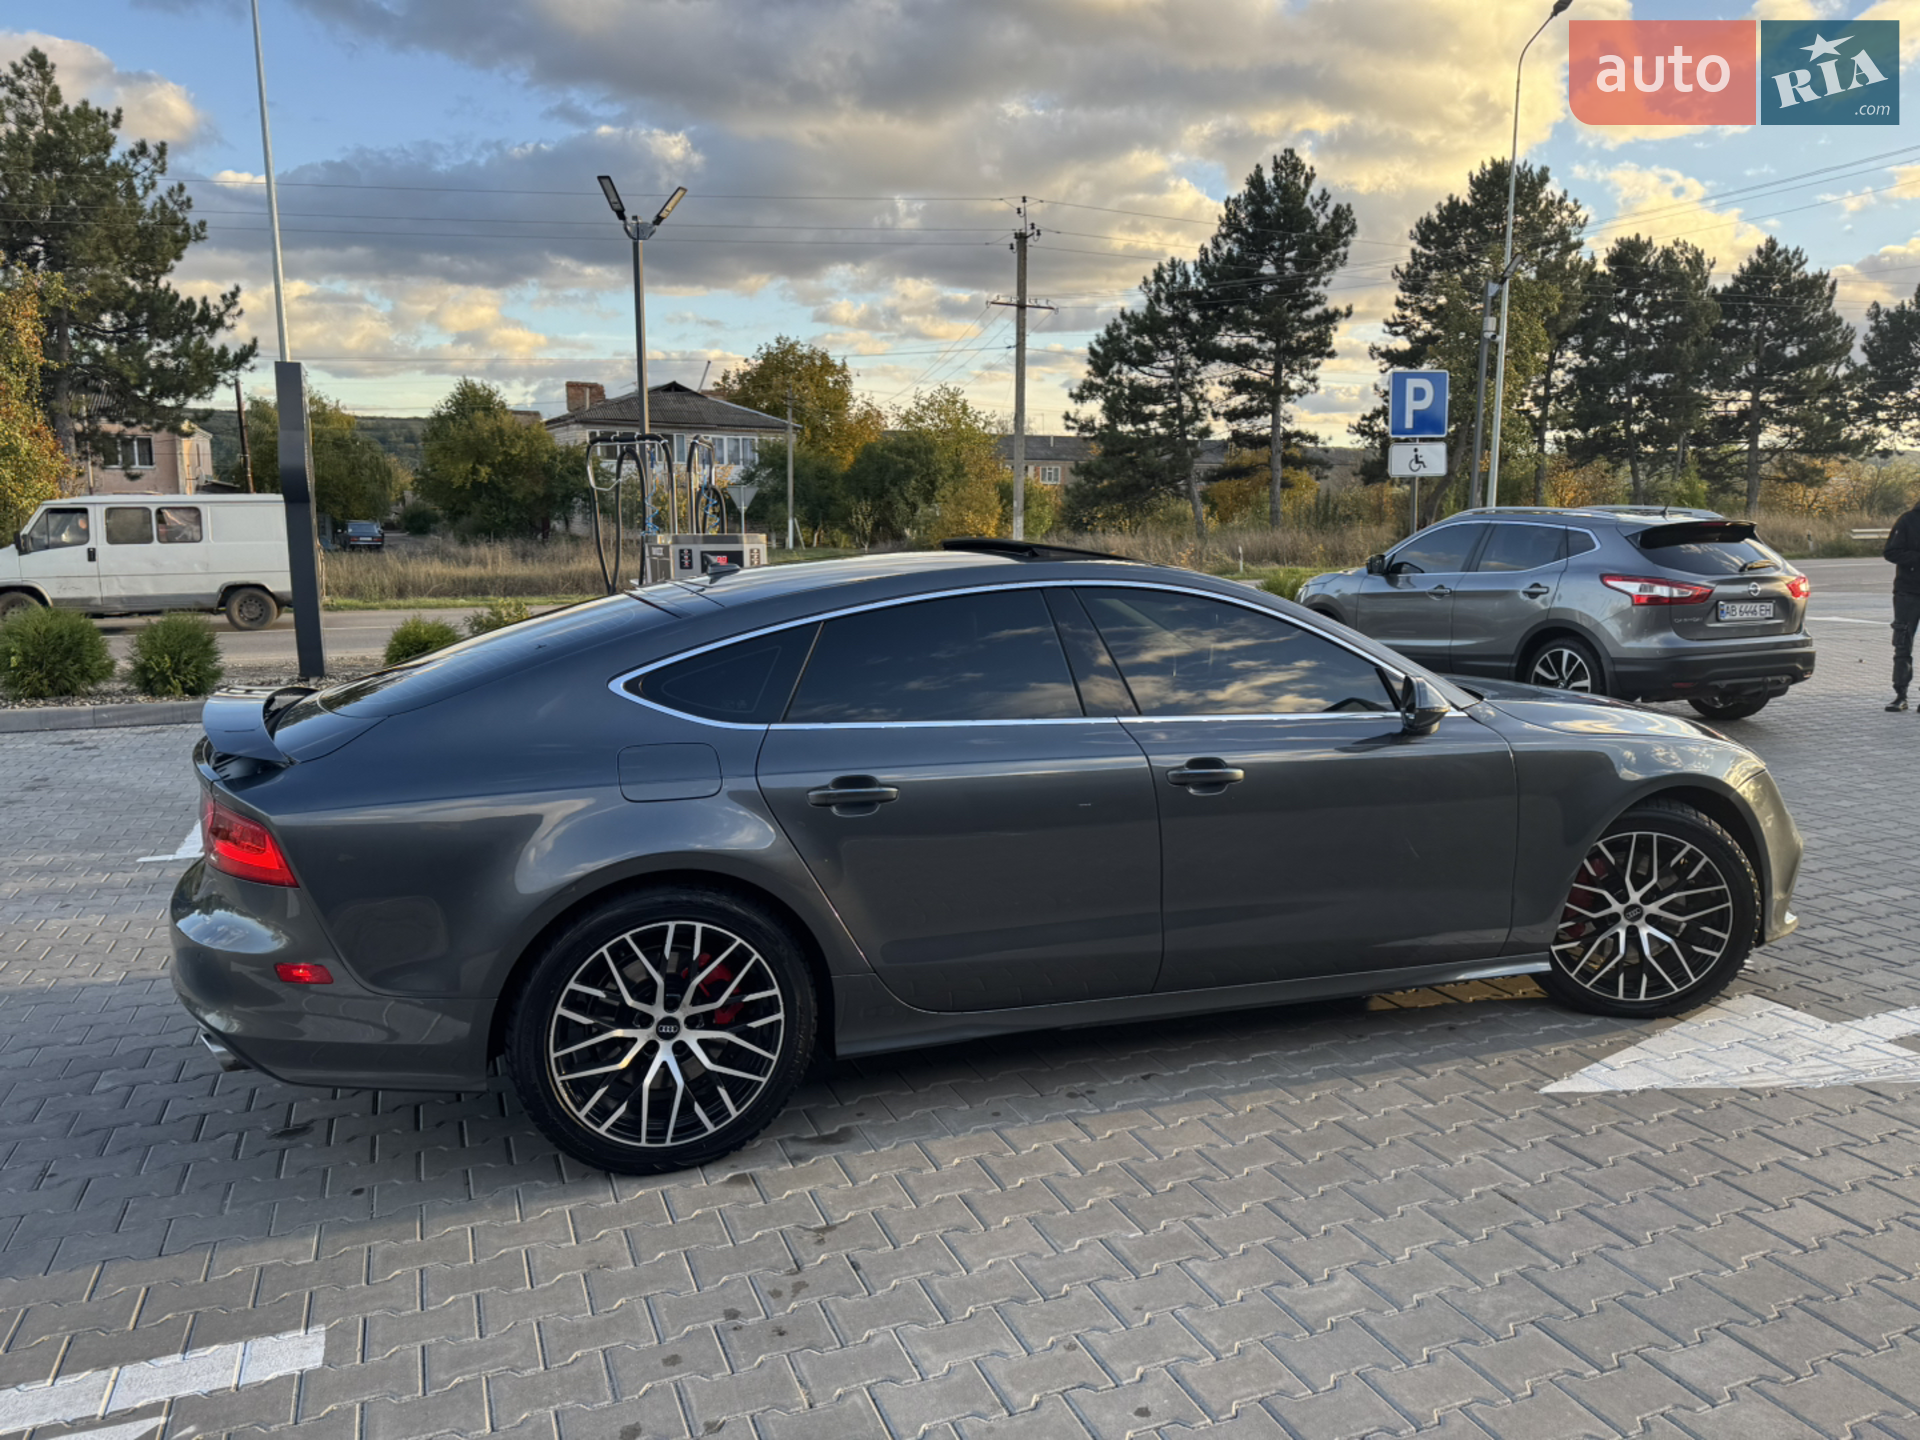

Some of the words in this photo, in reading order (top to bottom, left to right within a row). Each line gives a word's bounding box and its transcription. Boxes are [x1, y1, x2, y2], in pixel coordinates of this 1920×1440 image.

[1404, 378, 1434, 429] P
[1726, 604, 1737, 617] AB
[1759, 604, 1772, 617] EH
